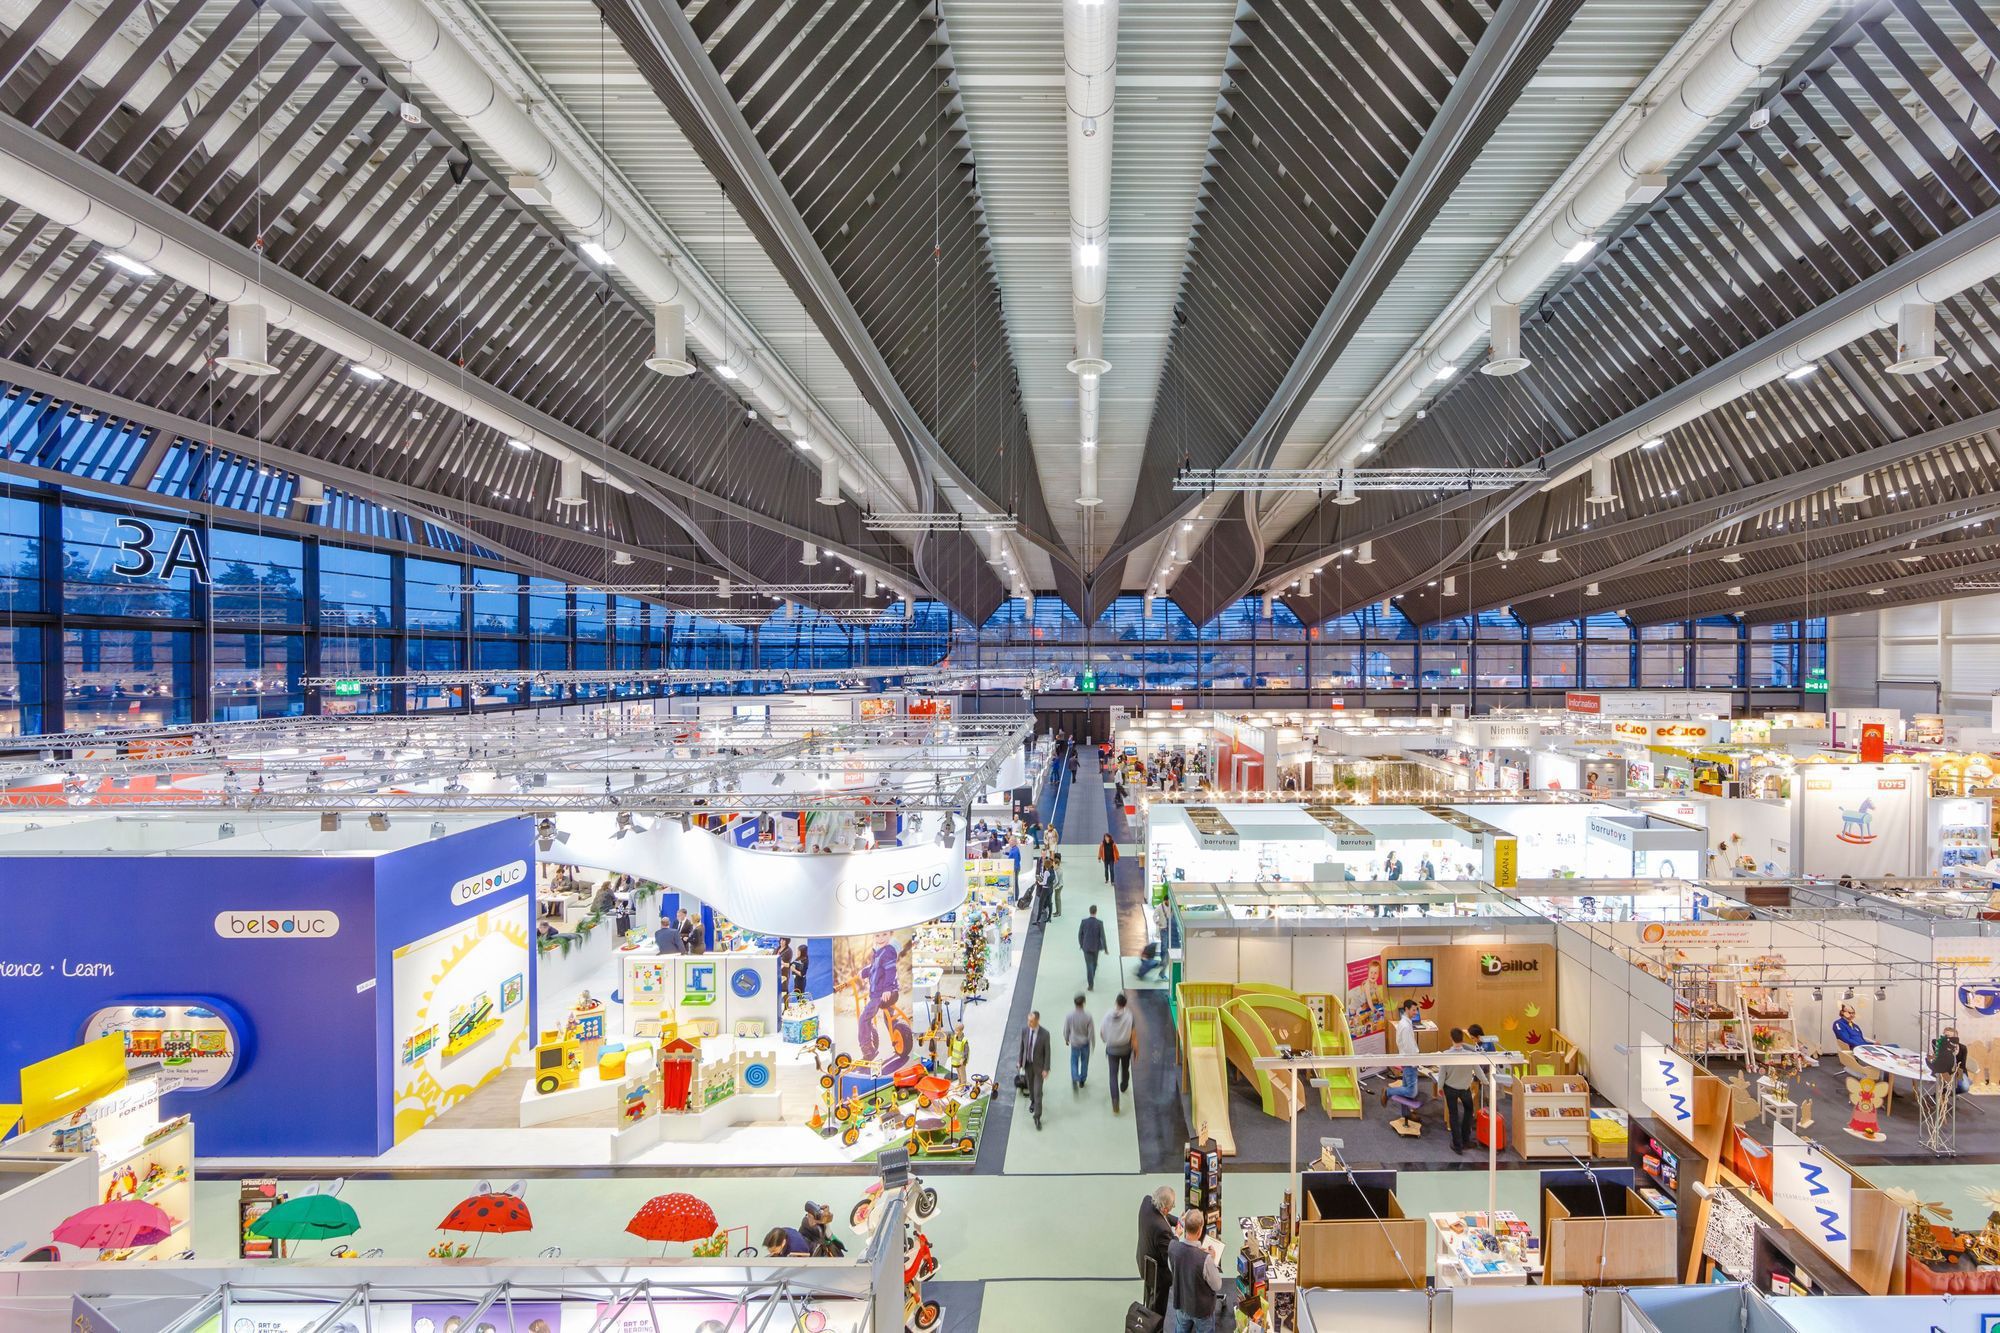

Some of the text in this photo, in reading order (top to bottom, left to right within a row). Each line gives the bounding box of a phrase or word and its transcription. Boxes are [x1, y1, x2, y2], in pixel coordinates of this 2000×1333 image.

[113, 517, 212, 585] 3A
[1568, 698, 1598, 709] Information
[1490, 725, 1529, 735] Nienhuis
[1879, 780, 1905, 788] TOYS
[1591, 822, 1627, 842] barrutoys
[1204, 838, 1237, 846] barrutoys
[1502, 857, 1510, 886] TUKAN
[0, 958, 115, 977] ience Learn
[1488, 958, 1539, 973] Daillot
[118, 1096, 159, 1119] FOR KIDS
[623, 1319, 649, 1328] ART OF
